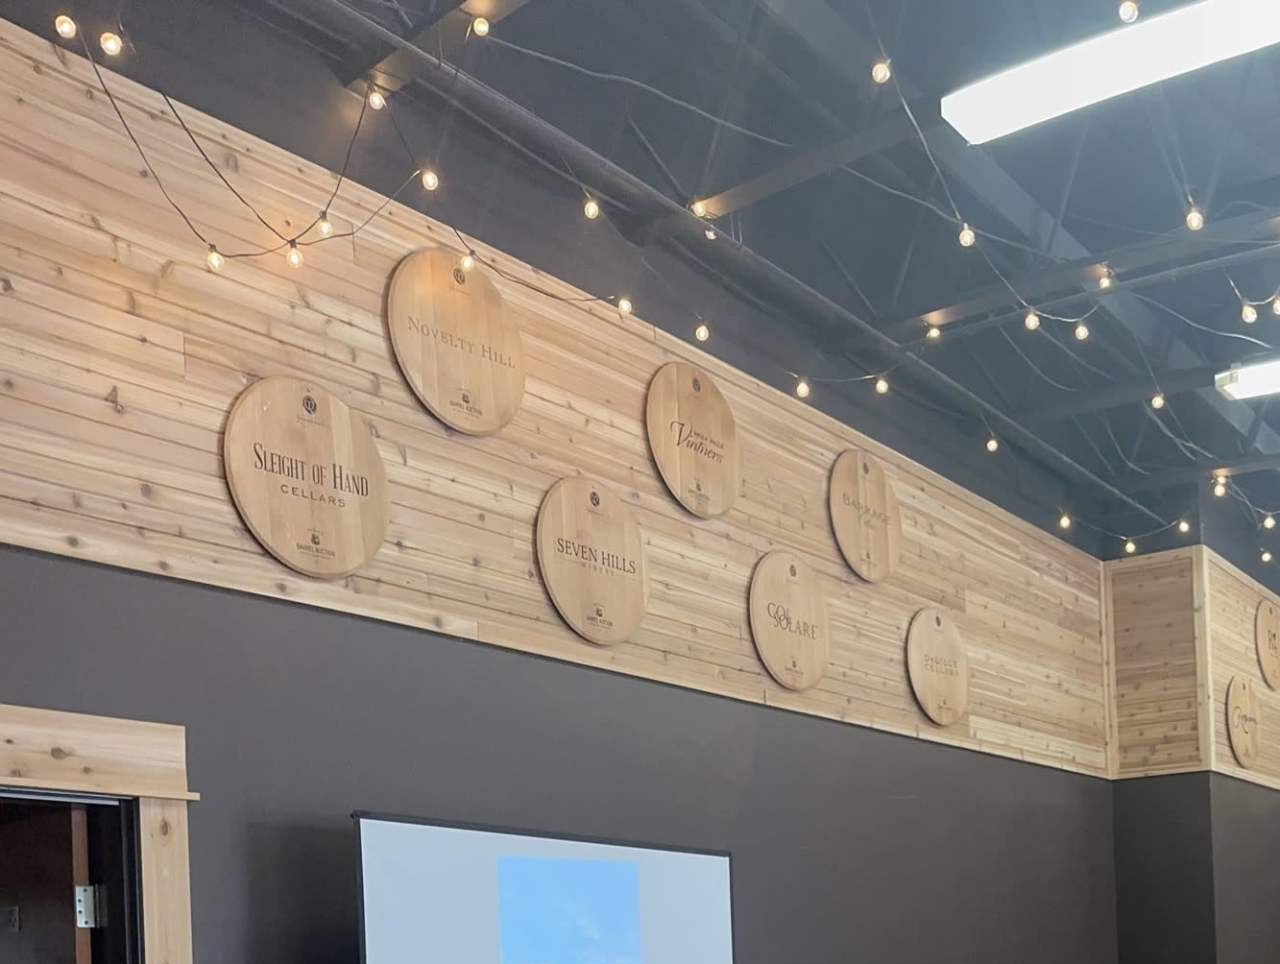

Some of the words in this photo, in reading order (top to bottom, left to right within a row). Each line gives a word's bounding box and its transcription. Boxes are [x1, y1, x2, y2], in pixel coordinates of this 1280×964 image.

[407, 315, 475, 354] NOVELTY
[481, 343, 516, 369] HILL
[670, 420, 723, 464] Vintners
[253, 442, 306, 481] SLEIGHT
[312, 463, 328, 485] OF
[333, 463, 369, 497] HAND
[280, 484, 346, 508] CELLARS
[557, 537, 598, 562] SEVEN
[601, 551, 637, 575] HILLS
[773, 614, 819, 641] SOLARE
